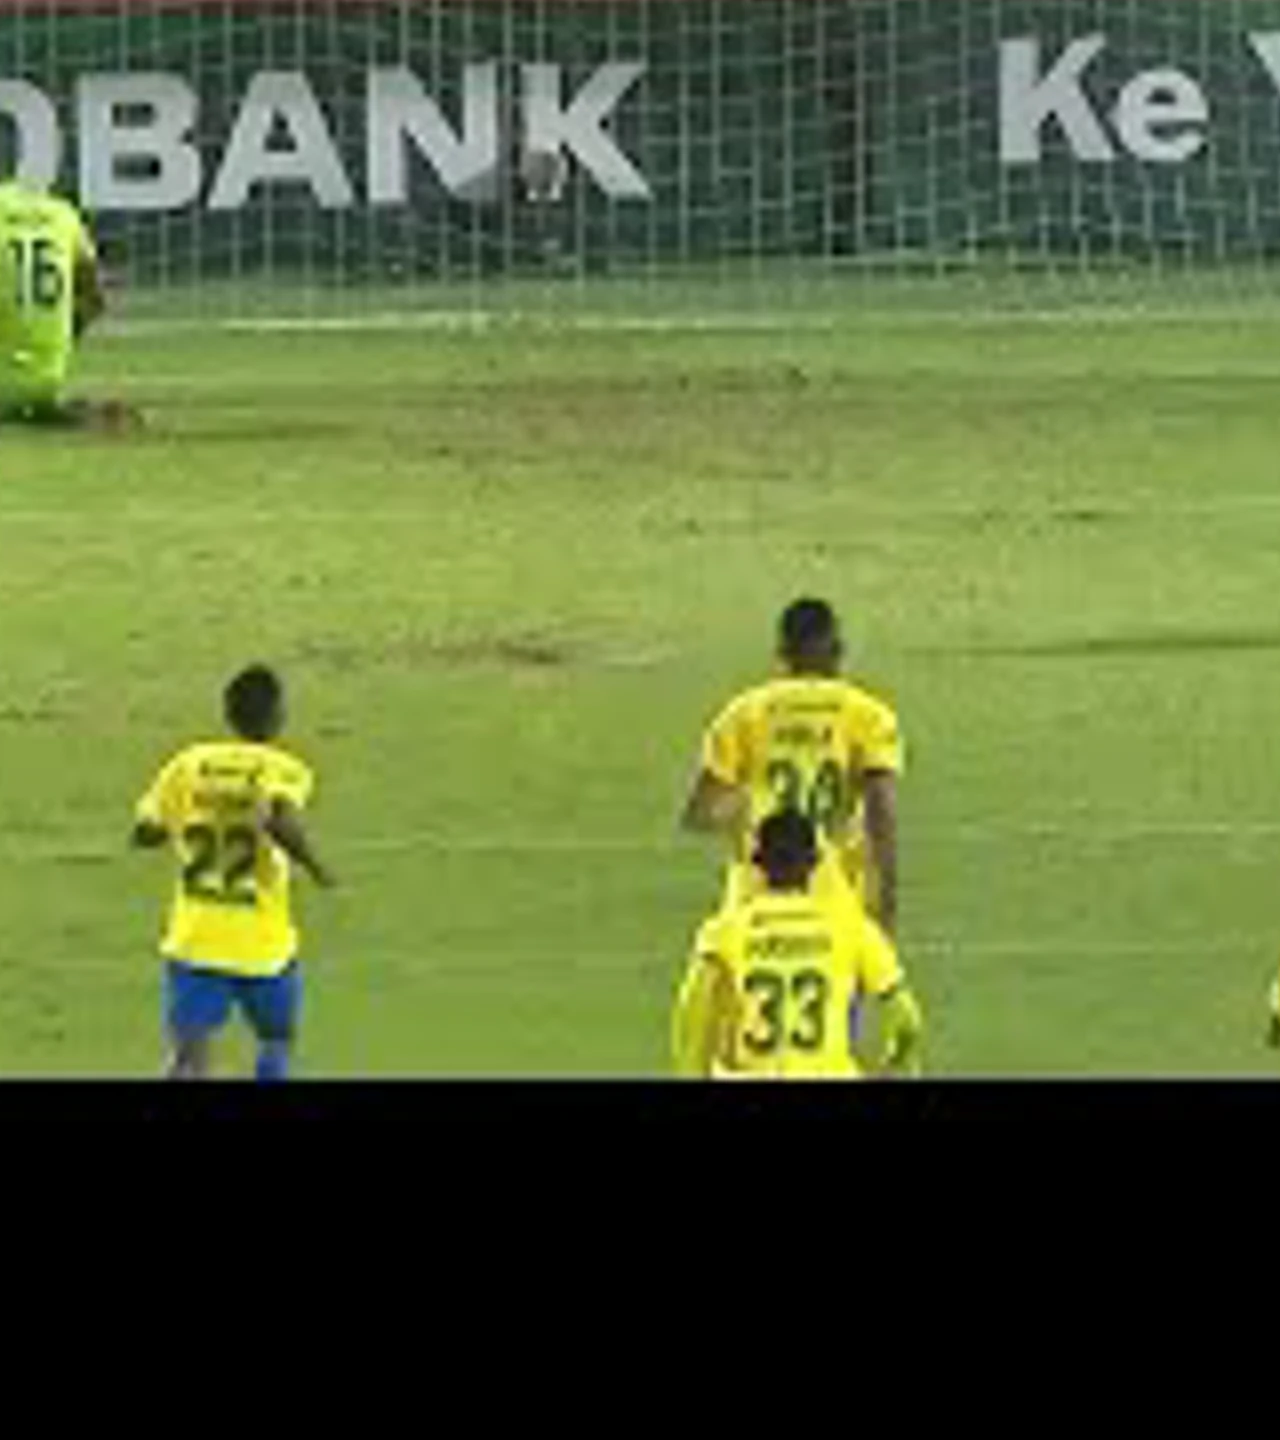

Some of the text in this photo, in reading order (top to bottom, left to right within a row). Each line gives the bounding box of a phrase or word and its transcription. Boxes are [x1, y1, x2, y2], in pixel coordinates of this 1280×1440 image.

[997, 32, 1209, 162] Ke
[7, 238, 65, 308] 16
[183, 824, 257, 907] 22
[743, 966, 827, 1054] 33
